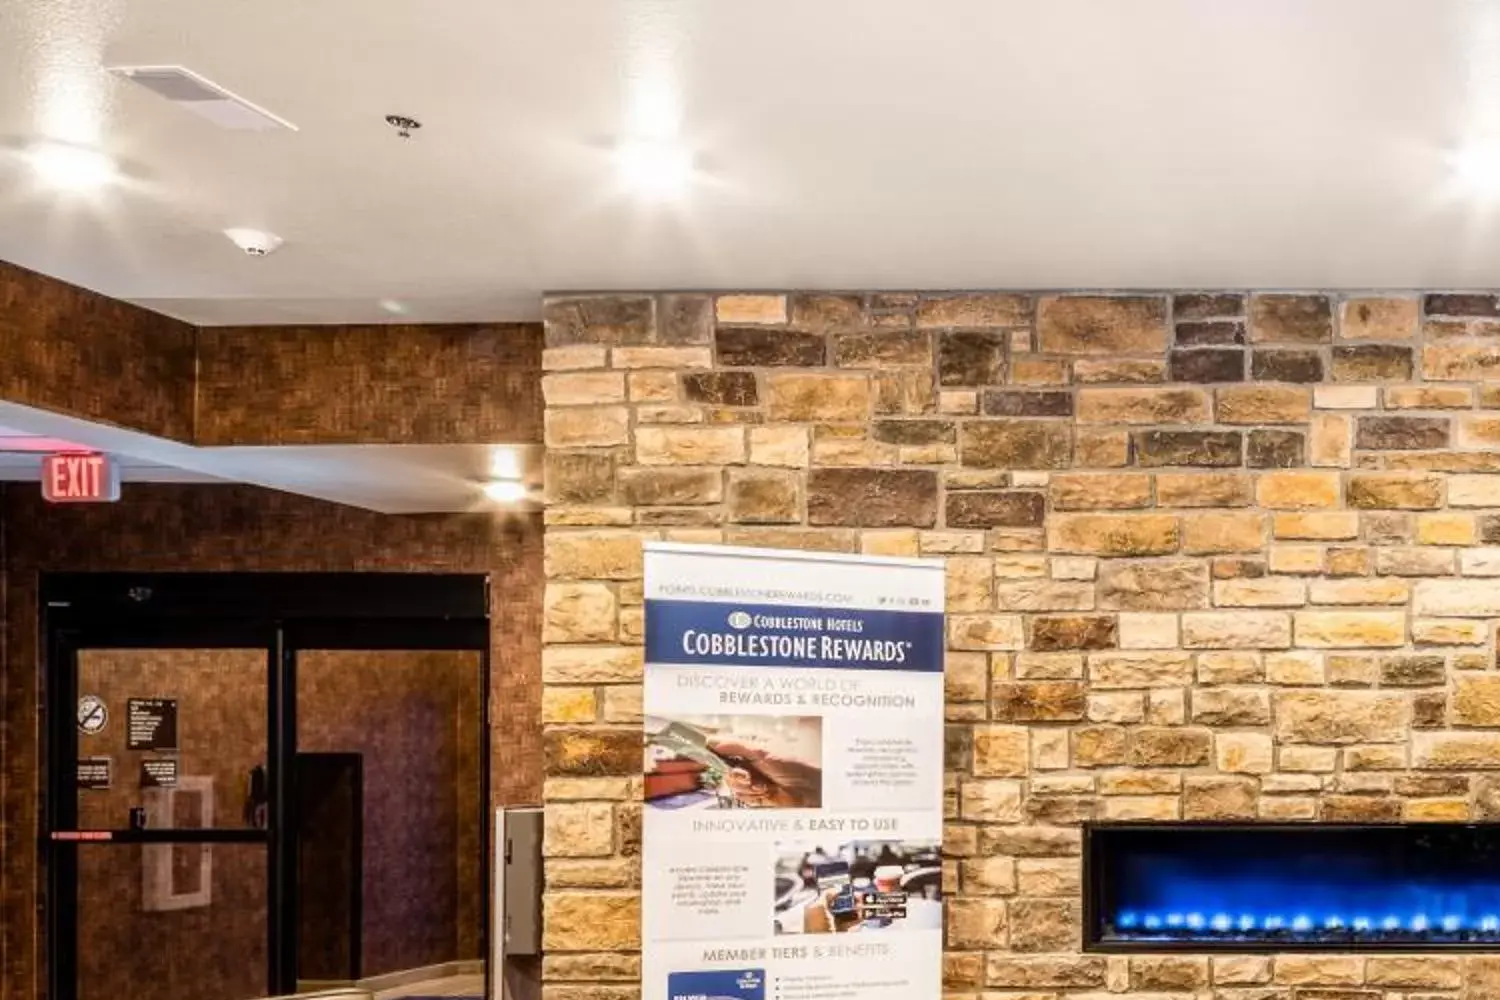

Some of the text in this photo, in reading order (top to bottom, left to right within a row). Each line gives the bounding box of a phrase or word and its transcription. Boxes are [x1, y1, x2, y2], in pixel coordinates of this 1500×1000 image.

[52, 457, 101, 497] EXIT
[754, 613, 864, 633] COBBLESTONE HOTELS
[682, 630, 906, 662] COBBLESTONE REWARDS
[677, 674, 860, 692] DISCOVER A WORLD OF
[797, 693, 807, 706] &
[813, 693, 916, 709] RECOGNITION
[693, 816, 898, 833] INNOVATIVE & EASY TO USE
[702, 943, 889, 962] MEMBER TIERS & BENEFITS
